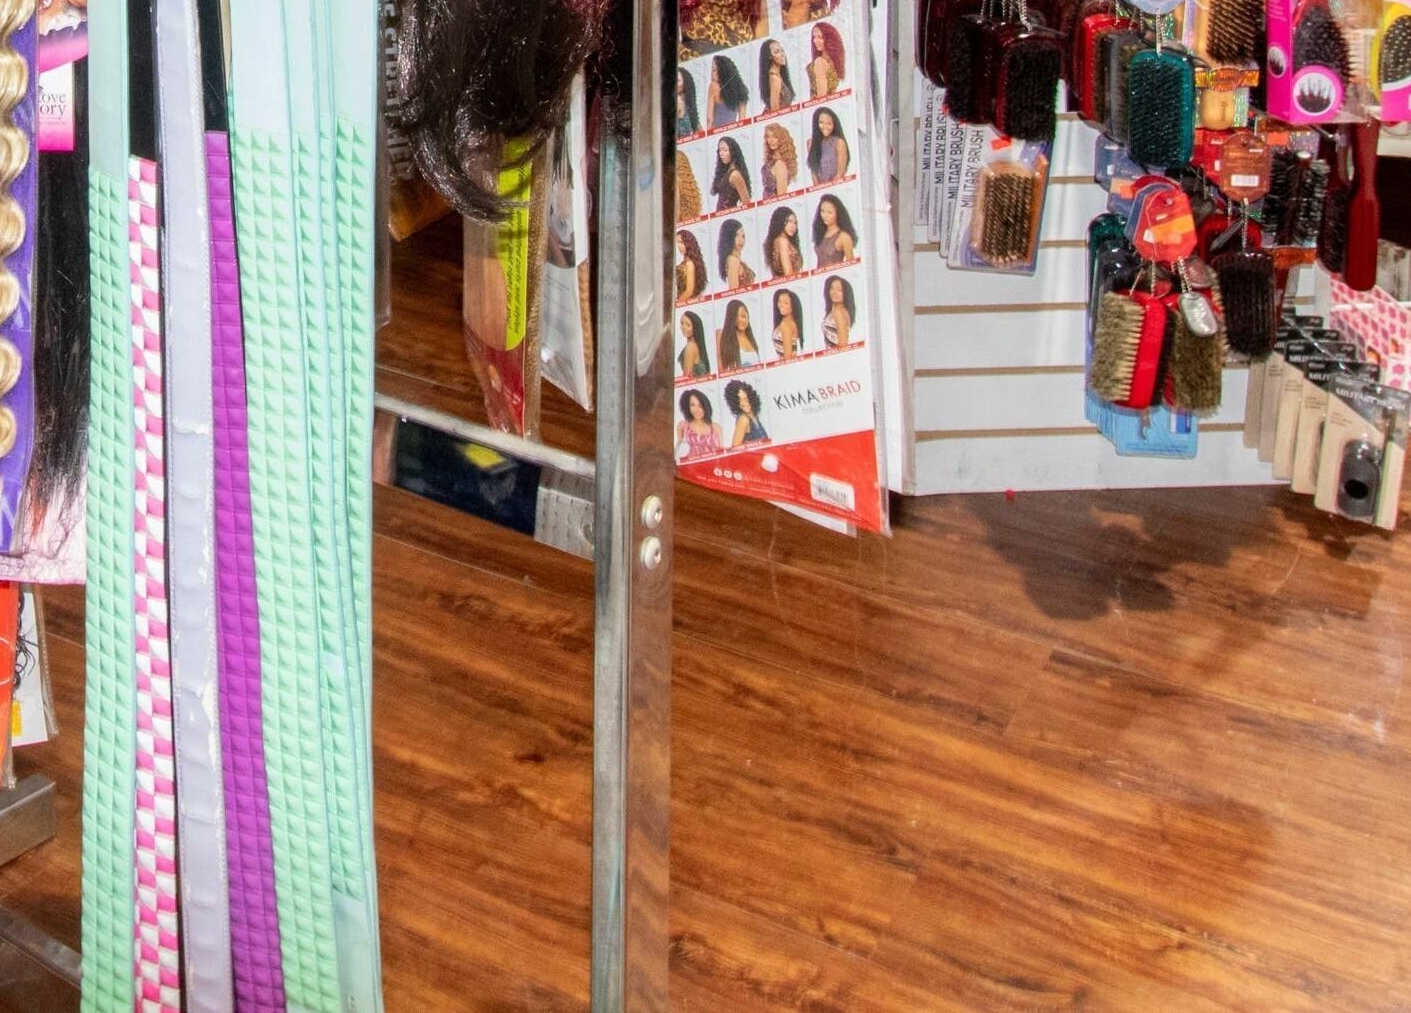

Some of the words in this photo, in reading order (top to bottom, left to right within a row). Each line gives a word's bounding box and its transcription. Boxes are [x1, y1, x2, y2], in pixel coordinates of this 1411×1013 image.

[950, 122, 965, 156] BRUSH
[968, 130, 985, 167] BRUSH
[947, 155, 963, 200] MILITARY
[961, 165, 979, 209] MILITARY
[773, 390, 818, 411] KIMA
[818, 379, 862, 401] BRAID
